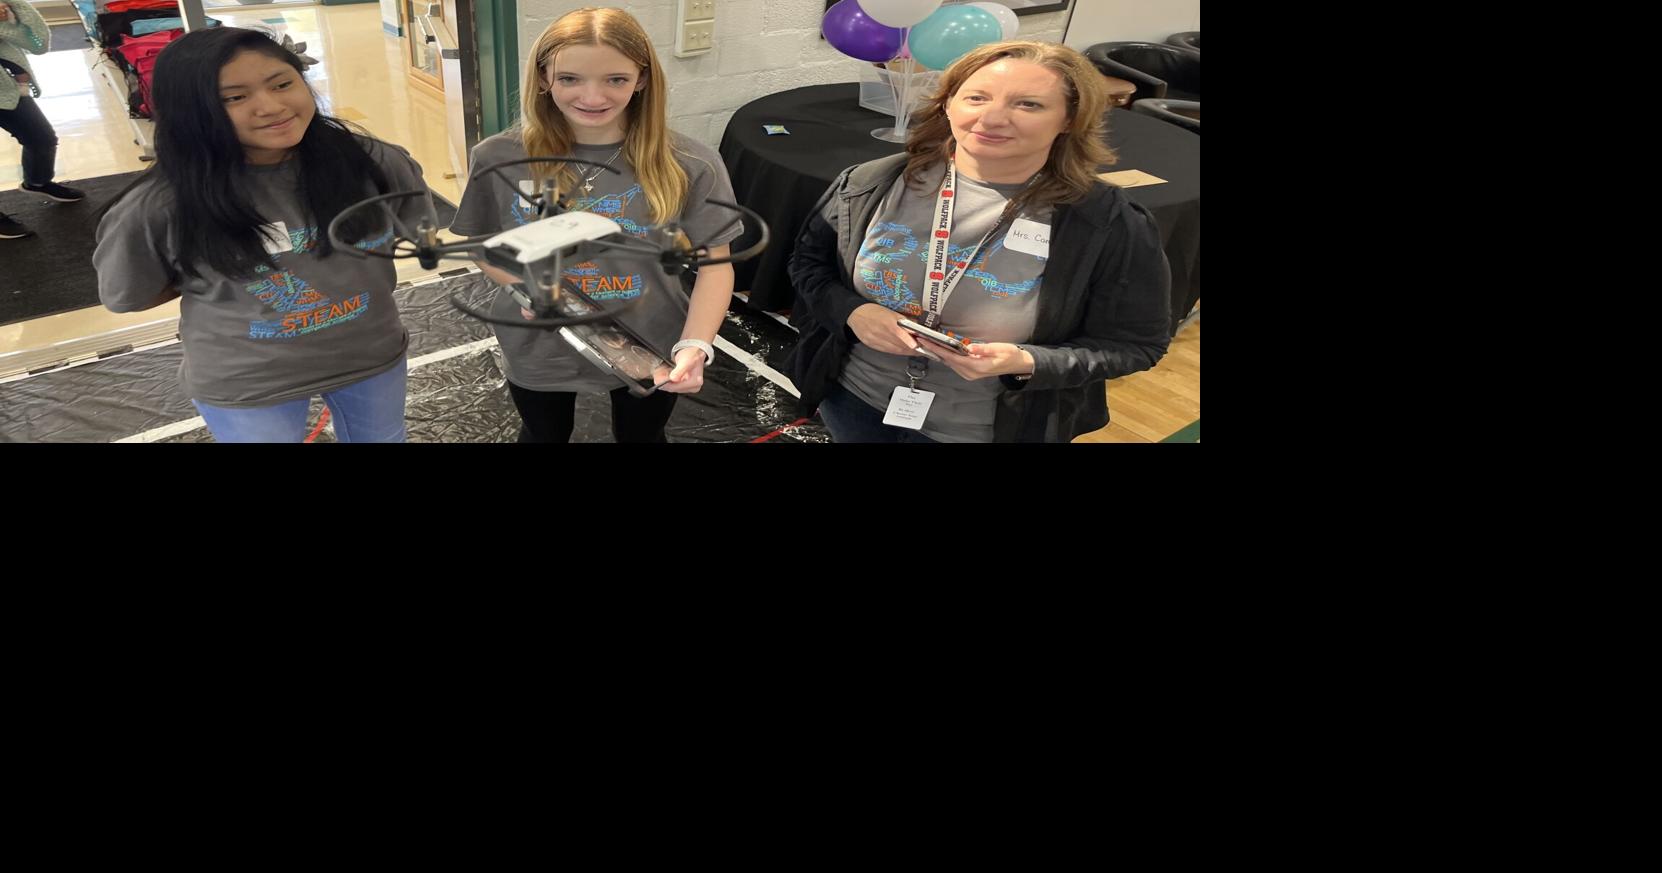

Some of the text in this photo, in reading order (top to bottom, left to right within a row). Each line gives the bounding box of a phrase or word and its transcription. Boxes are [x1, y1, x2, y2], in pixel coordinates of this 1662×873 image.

[939, 199, 950, 229] WOLFPACK
[933, 240, 945, 271] WOLFPACK
[928, 281, 940, 313] WOLFPACK
[282, 295, 362, 334] STEAM
